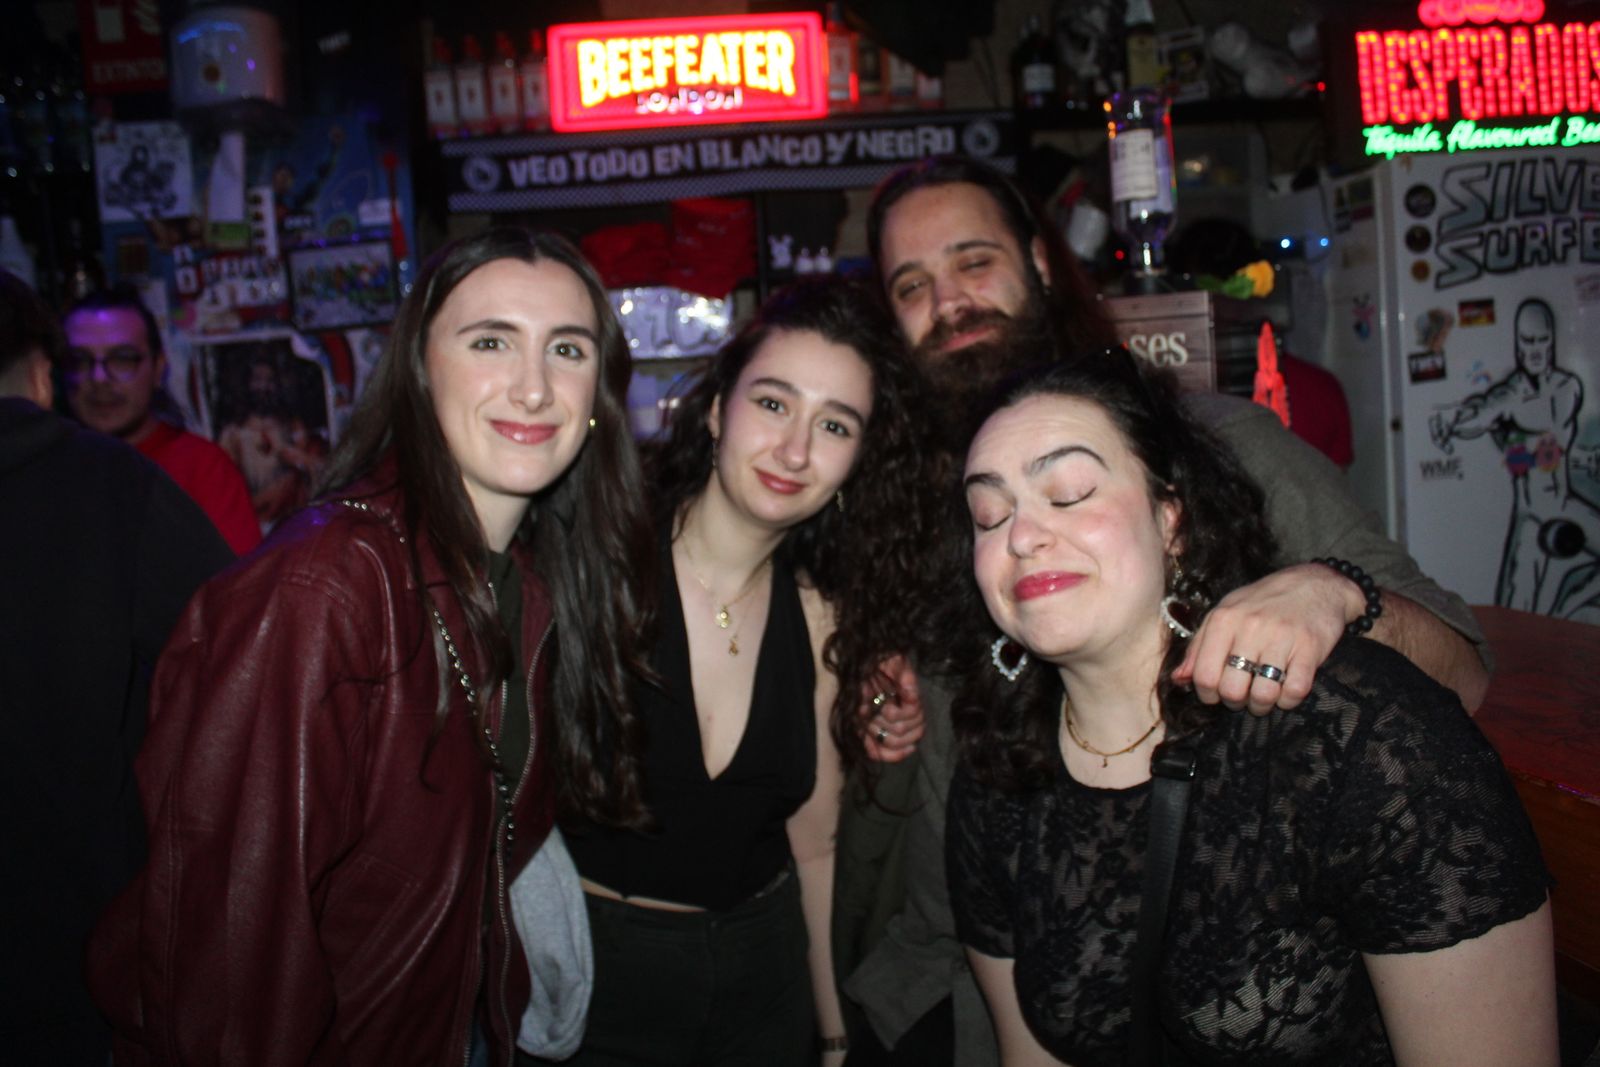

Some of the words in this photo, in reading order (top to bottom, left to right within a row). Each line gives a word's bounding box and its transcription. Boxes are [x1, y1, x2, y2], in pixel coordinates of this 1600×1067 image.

[577, 29, 797, 107] BEEFEATER
[507, 154, 569, 188] VEO
[653, 141, 697, 176] EN
[698, 132, 824, 170] BLANCO
[854, 124, 956, 160] NEGRO
[1362, 122, 1443, 160] Tequila
